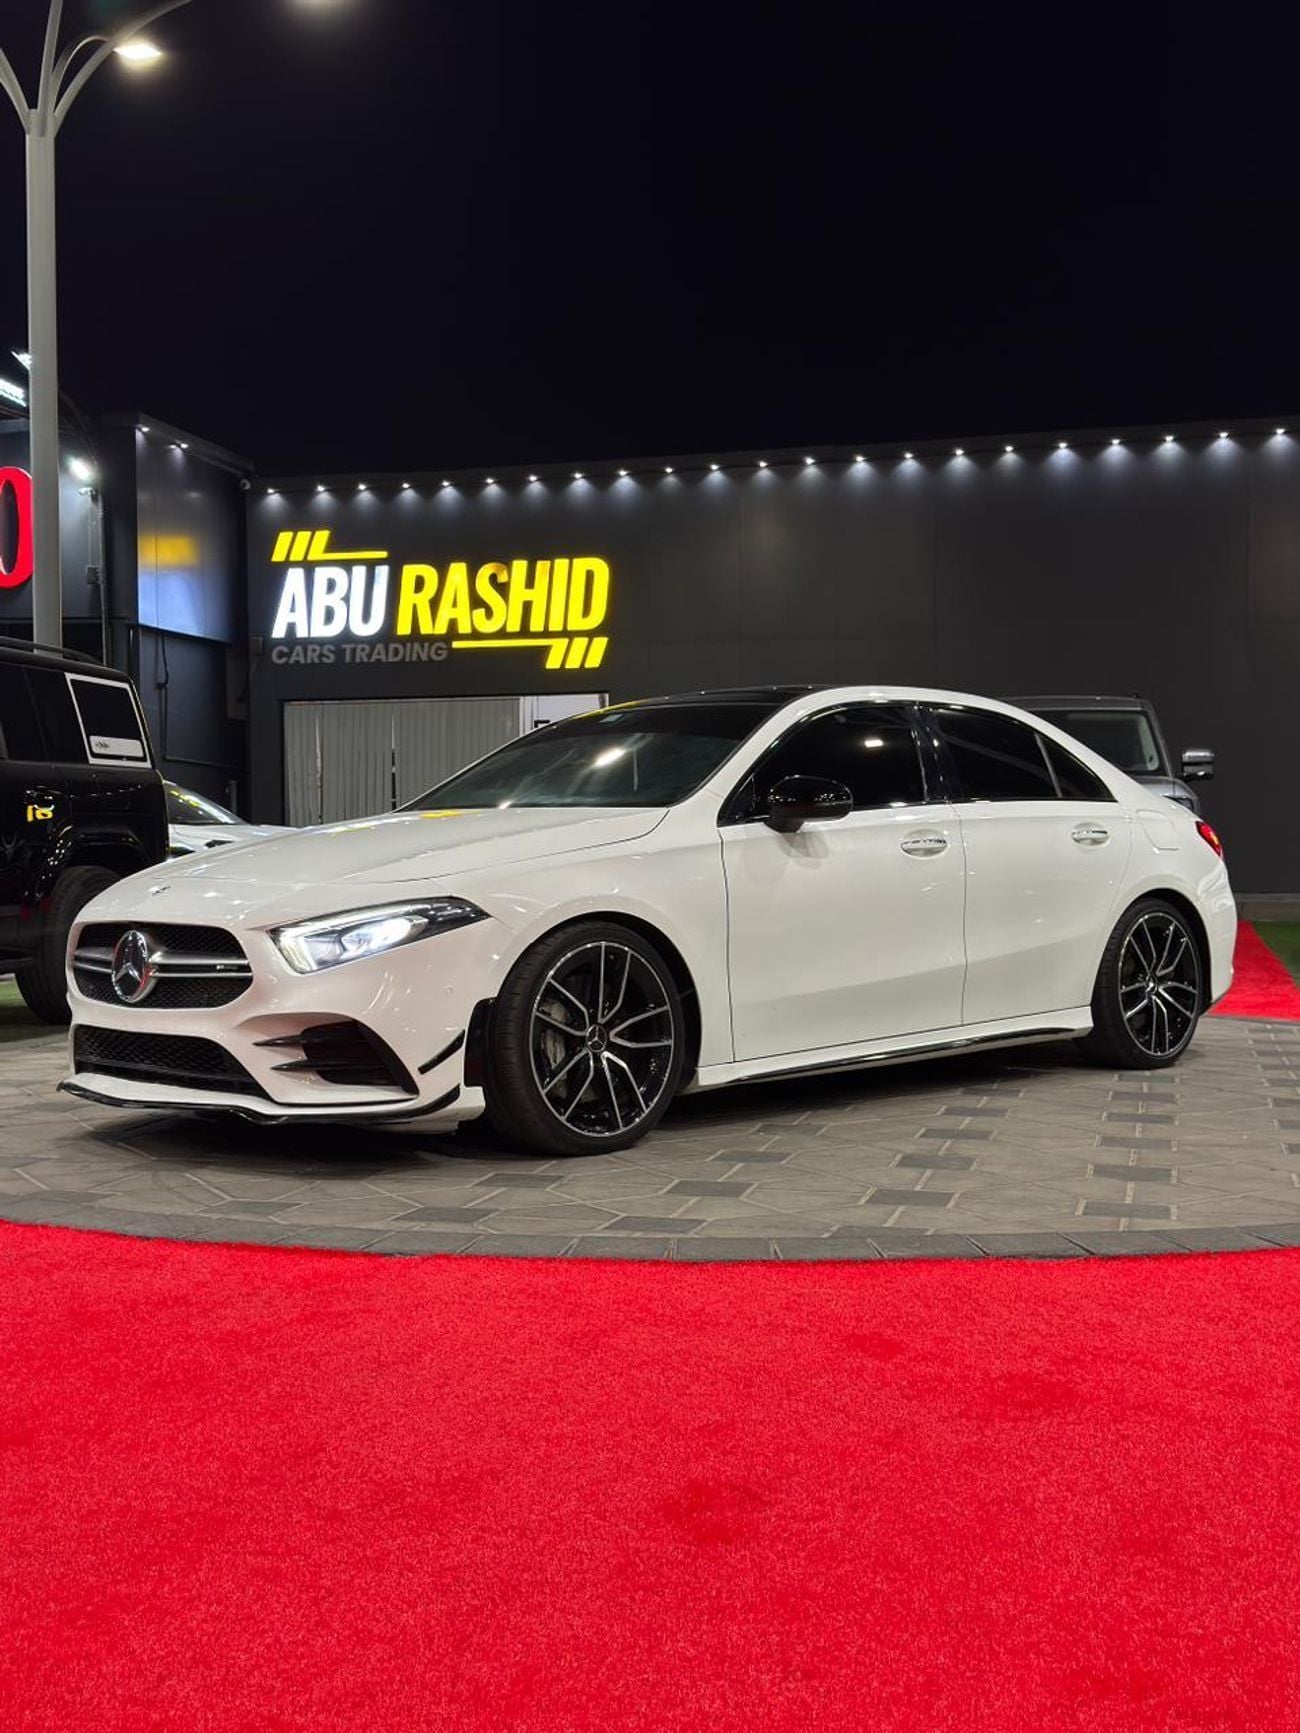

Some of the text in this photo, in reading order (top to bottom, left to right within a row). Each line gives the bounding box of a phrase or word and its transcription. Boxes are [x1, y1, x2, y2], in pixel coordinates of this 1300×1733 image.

[271, 557, 610, 639] ABU RASHID
[271, 641, 449, 664] CARS TRADING
